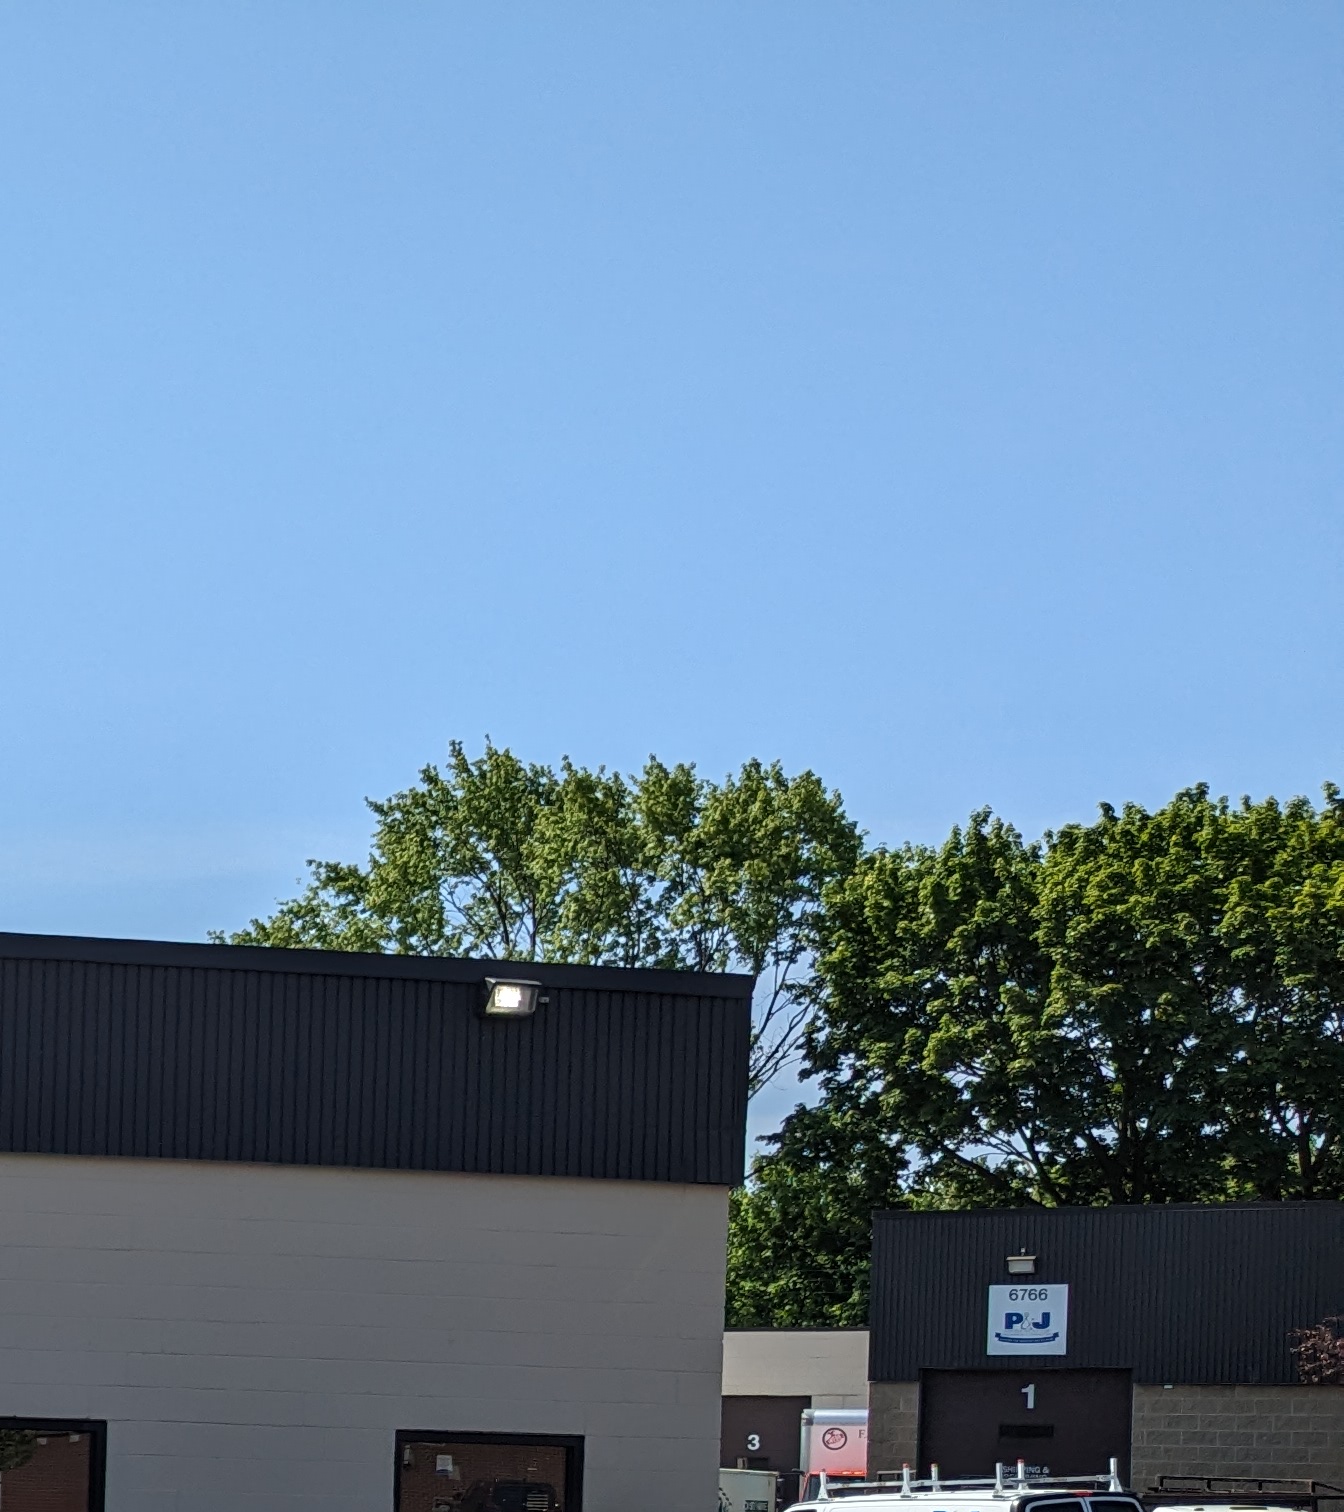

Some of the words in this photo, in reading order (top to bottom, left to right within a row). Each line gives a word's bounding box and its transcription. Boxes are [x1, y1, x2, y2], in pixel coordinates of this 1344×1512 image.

[1008, 1288, 1049, 1302] 6766
[1021, 1383, 1035, 1409] 1
[747, 1434, 761, 1451] 3
